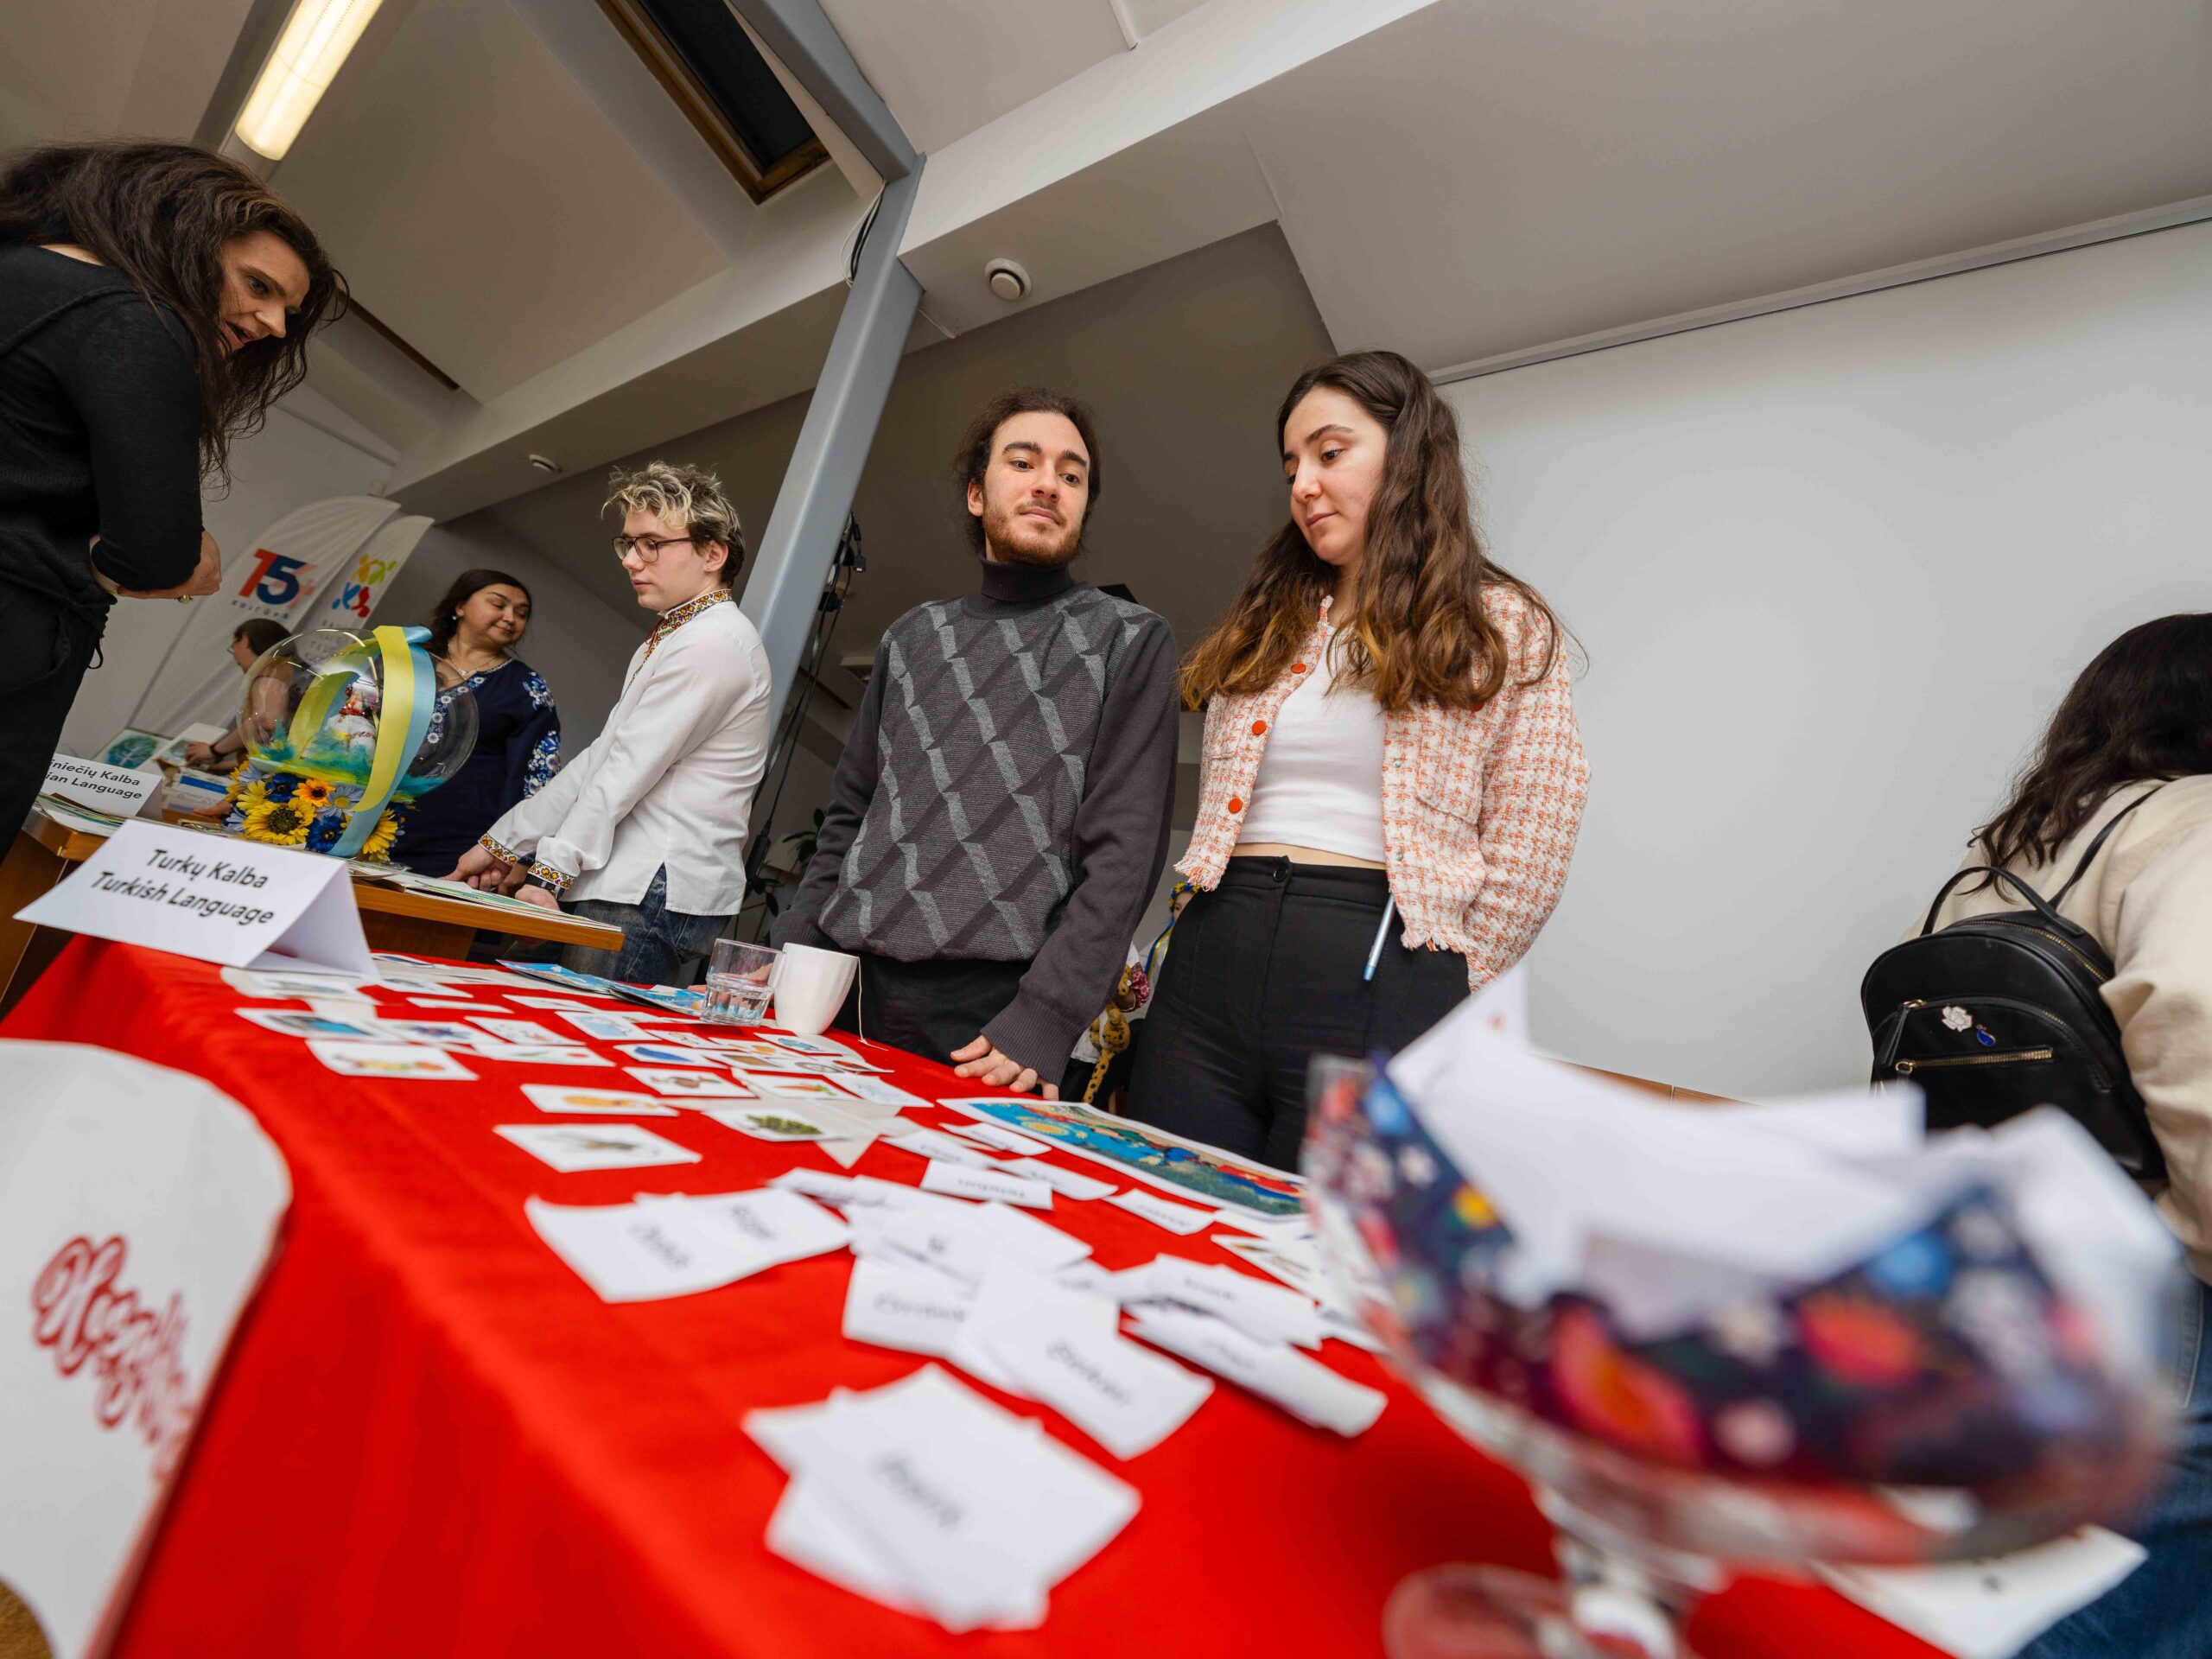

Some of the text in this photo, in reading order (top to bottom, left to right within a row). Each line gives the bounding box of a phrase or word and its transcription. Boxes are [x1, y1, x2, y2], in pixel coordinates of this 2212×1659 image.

[71, 778, 143, 799] Language
[100, 771, 140, 785] Kalba
[147, 849, 269, 888] Turkų Kalba
[92, 871, 274, 926] Turkish Language
